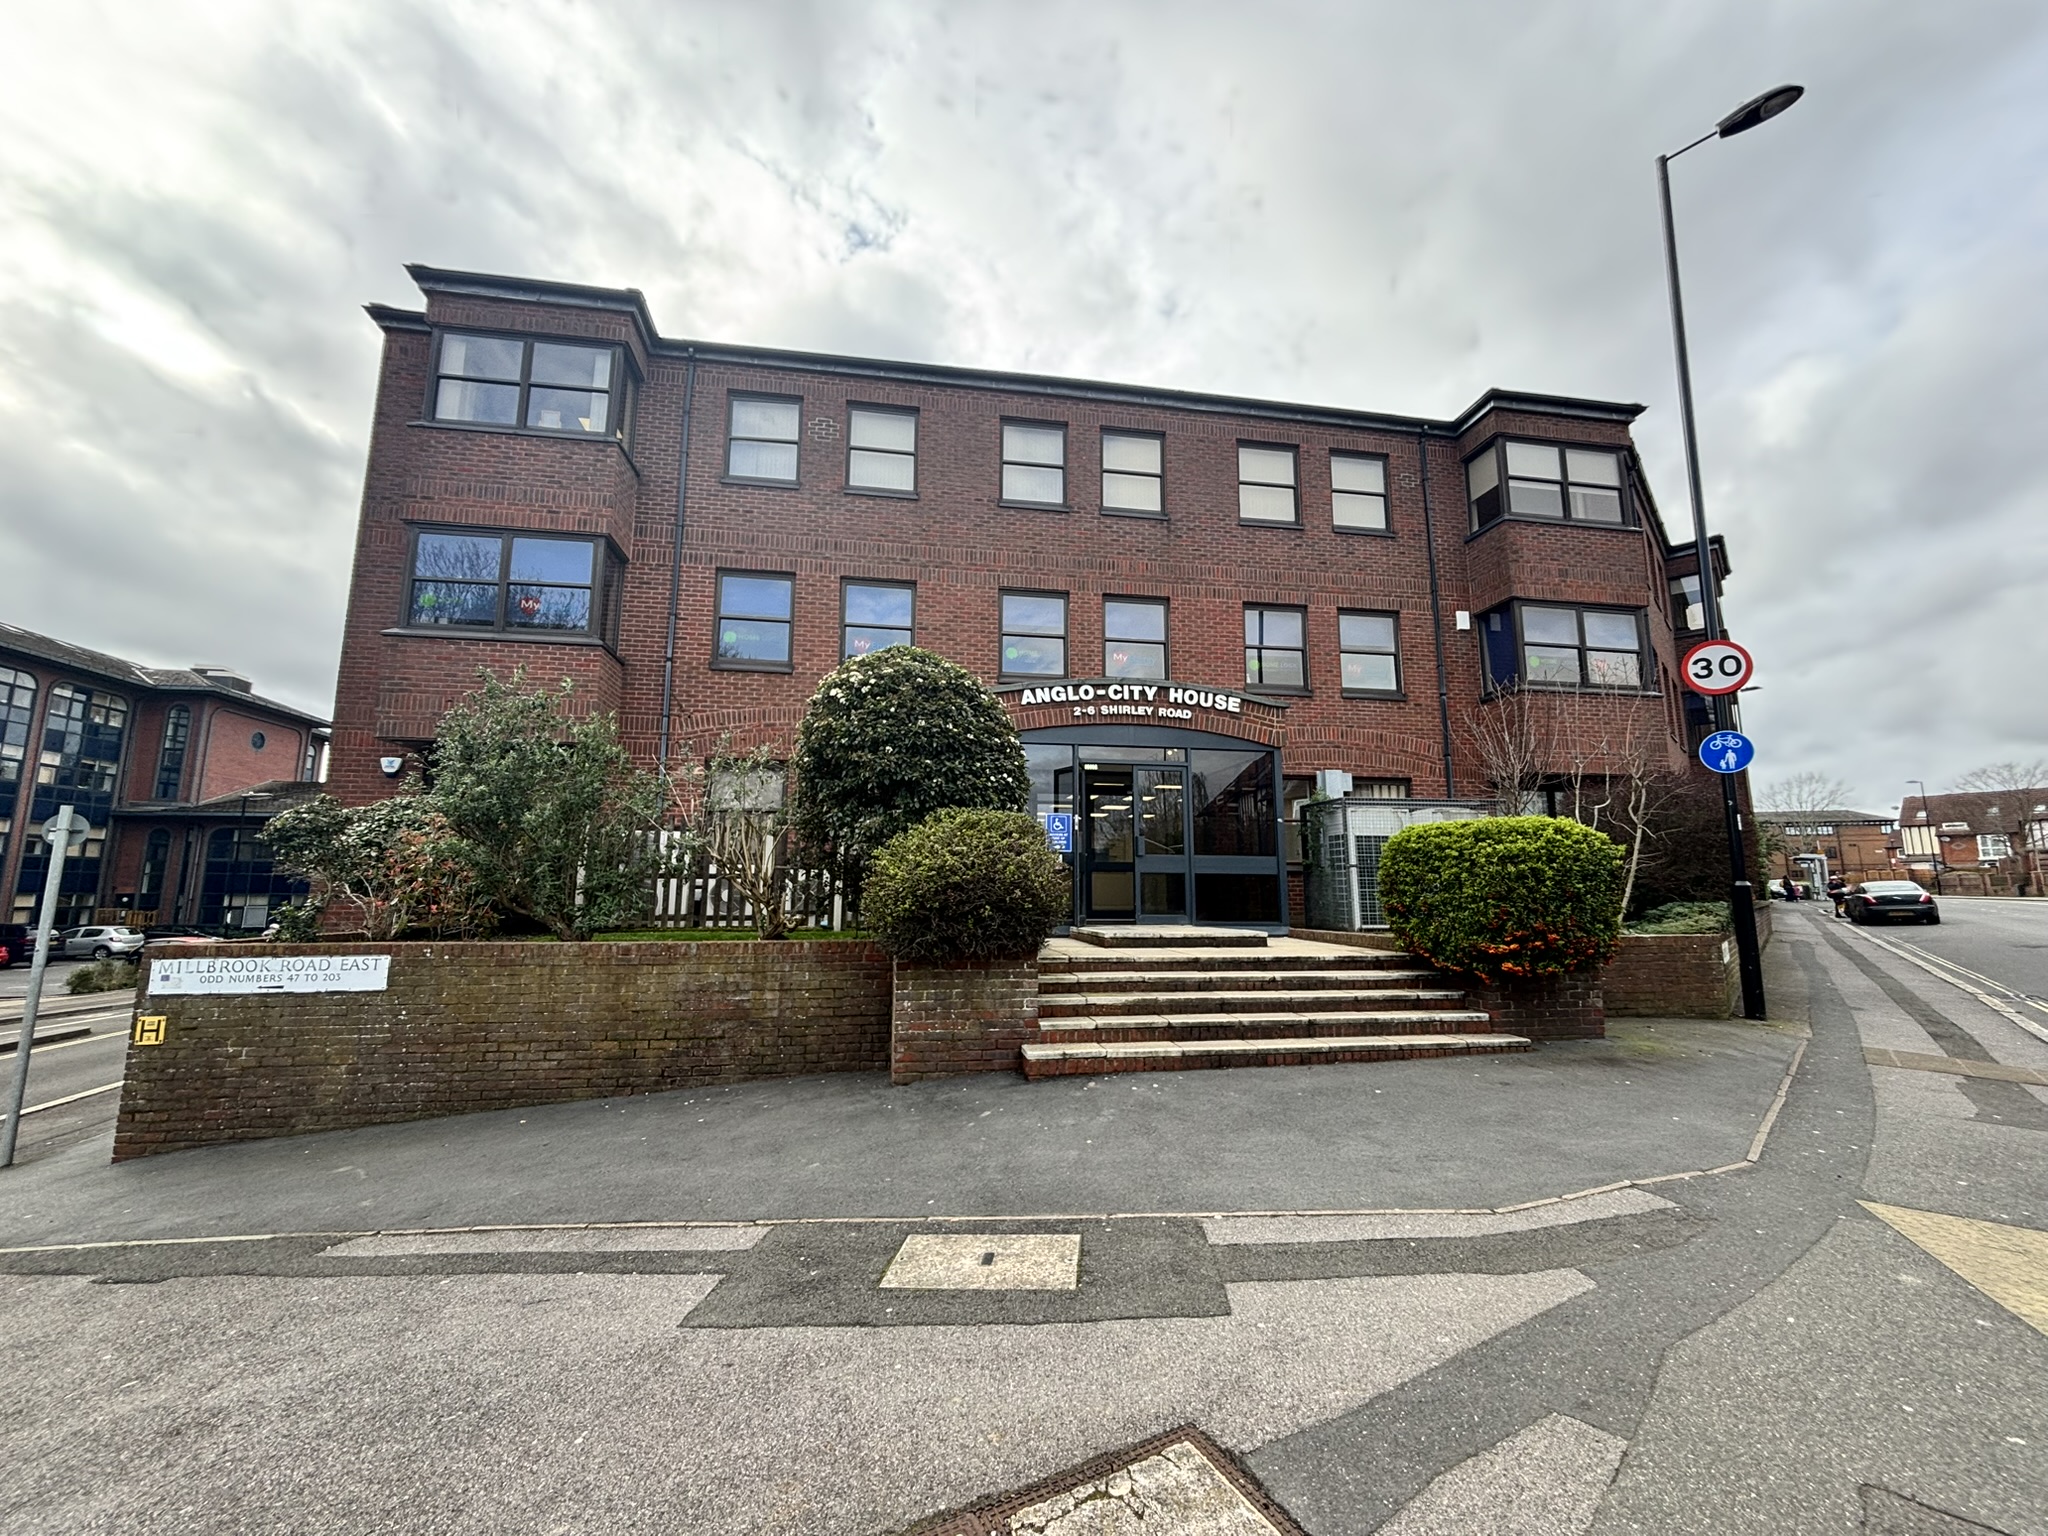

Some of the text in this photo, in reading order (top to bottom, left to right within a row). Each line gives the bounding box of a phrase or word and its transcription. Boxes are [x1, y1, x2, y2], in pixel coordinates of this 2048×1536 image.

[520, 599, 540, 610] My
[854, 639, 871, 650] My
[1113, 653, 1128, 663] My
[1691, 654, 1742, 679] 30
[1020, 683, 1241, 713] ANGLO-CITY HOUSE
[1073, 704, 1192, 720] 2-6 SHIRLEY ROAD
[158, 956, 382, 975] MILLBROOK ROAD EAST
[199, 971, 342, 985] ODD NUMBERS 47 TO 203
[139, 1018, 162, 1043] H
